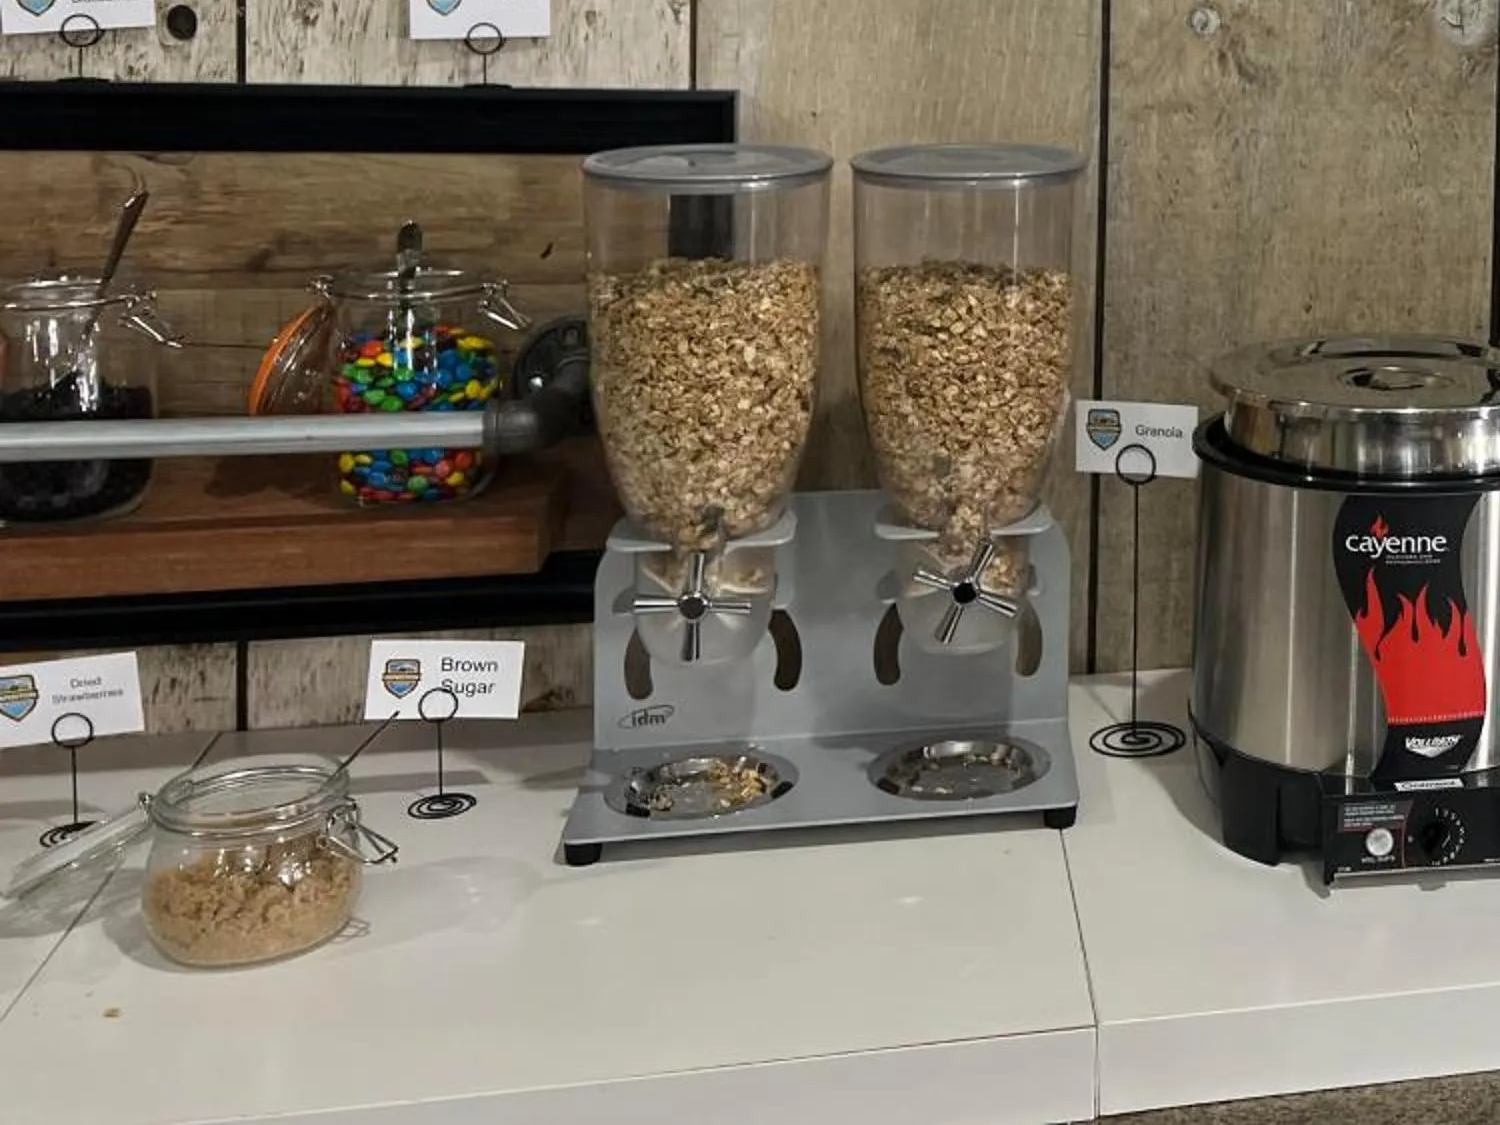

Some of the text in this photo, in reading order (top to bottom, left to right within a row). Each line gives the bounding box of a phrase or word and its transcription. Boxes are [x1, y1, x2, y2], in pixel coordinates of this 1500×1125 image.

[1135, 424, 1183, 439] Granola
[1345, 535, 1447, 558] cayenne
[441, 657, 499, 673] Brown
[440, 678, 496, 697] Sugar
[631, 711, 666, 728] idm
